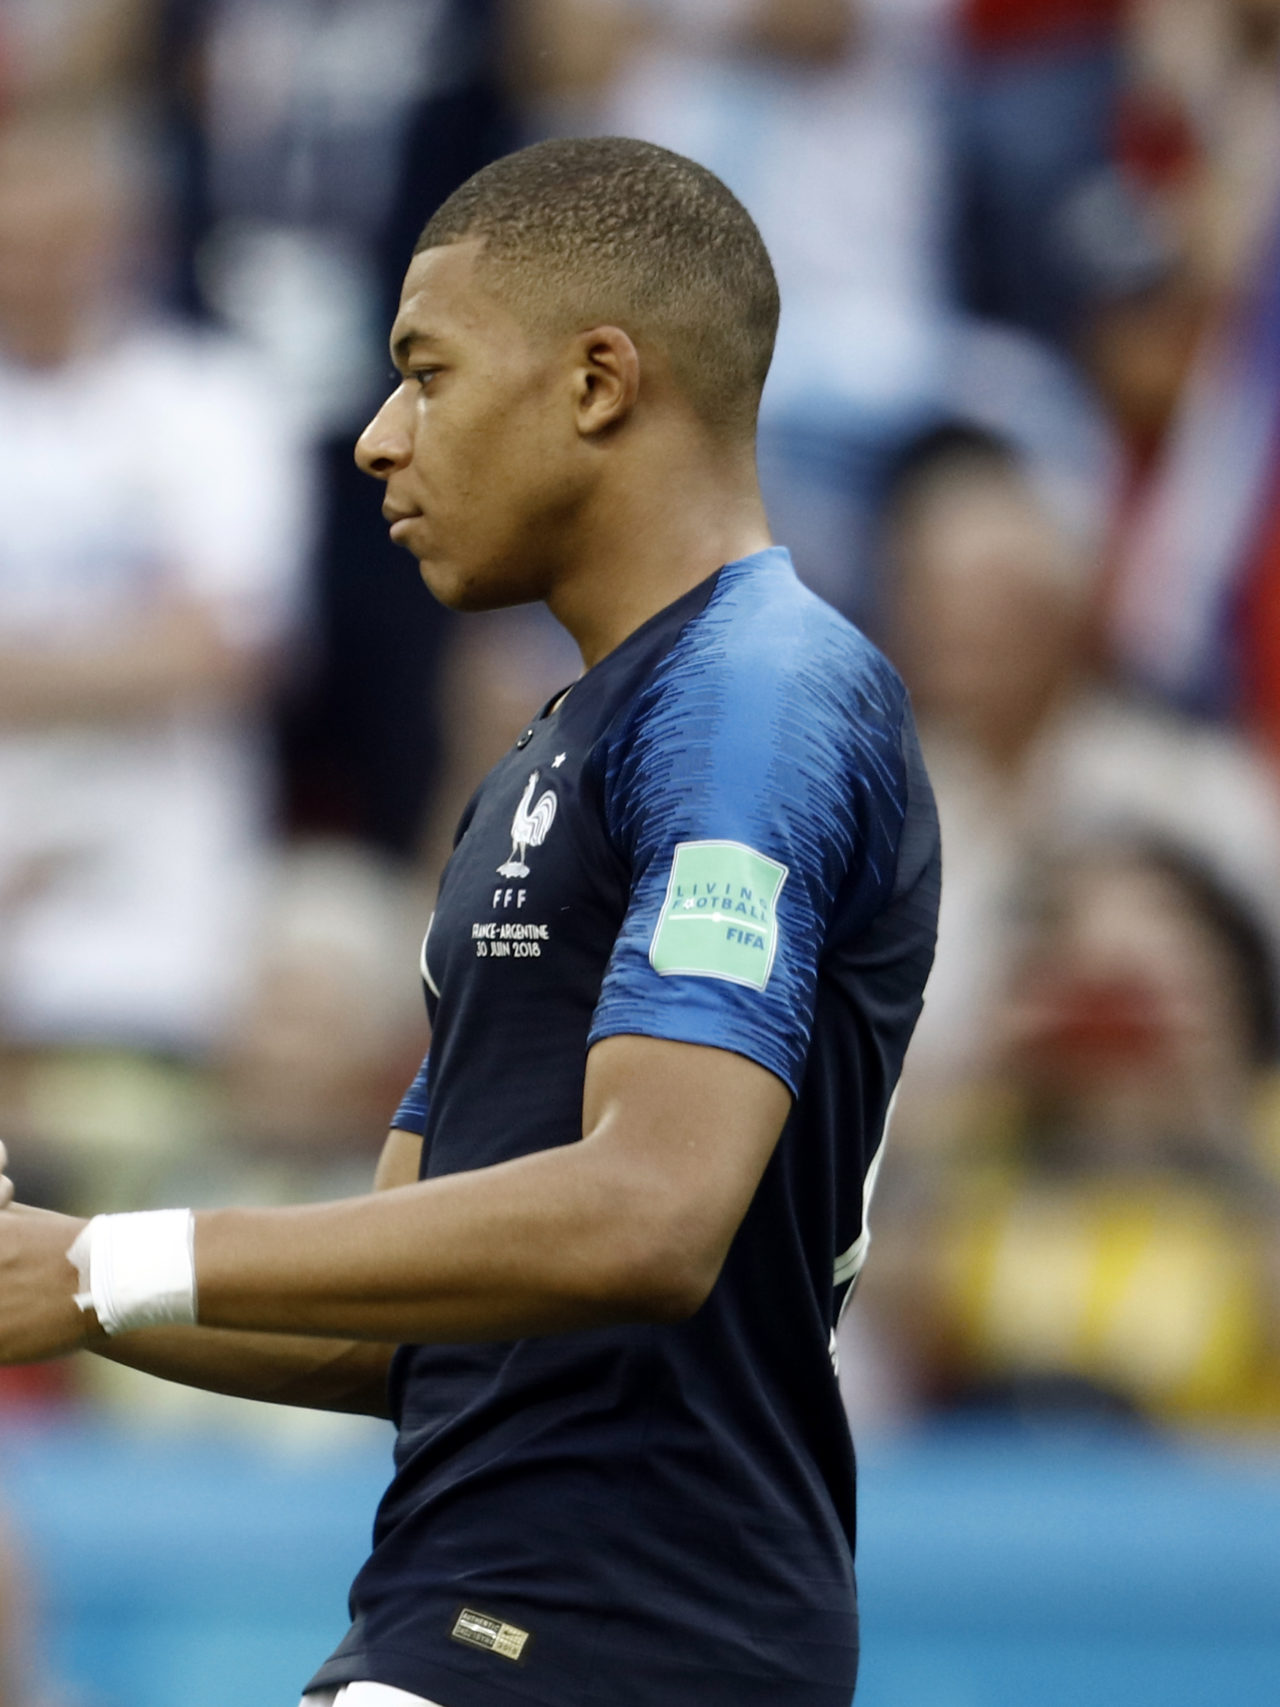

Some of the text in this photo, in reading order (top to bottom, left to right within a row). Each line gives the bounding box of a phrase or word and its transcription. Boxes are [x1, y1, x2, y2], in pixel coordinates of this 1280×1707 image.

[726, 927, 765, 951] FIFA
[476, 941, 541, 958] 30 JUIN 2018
